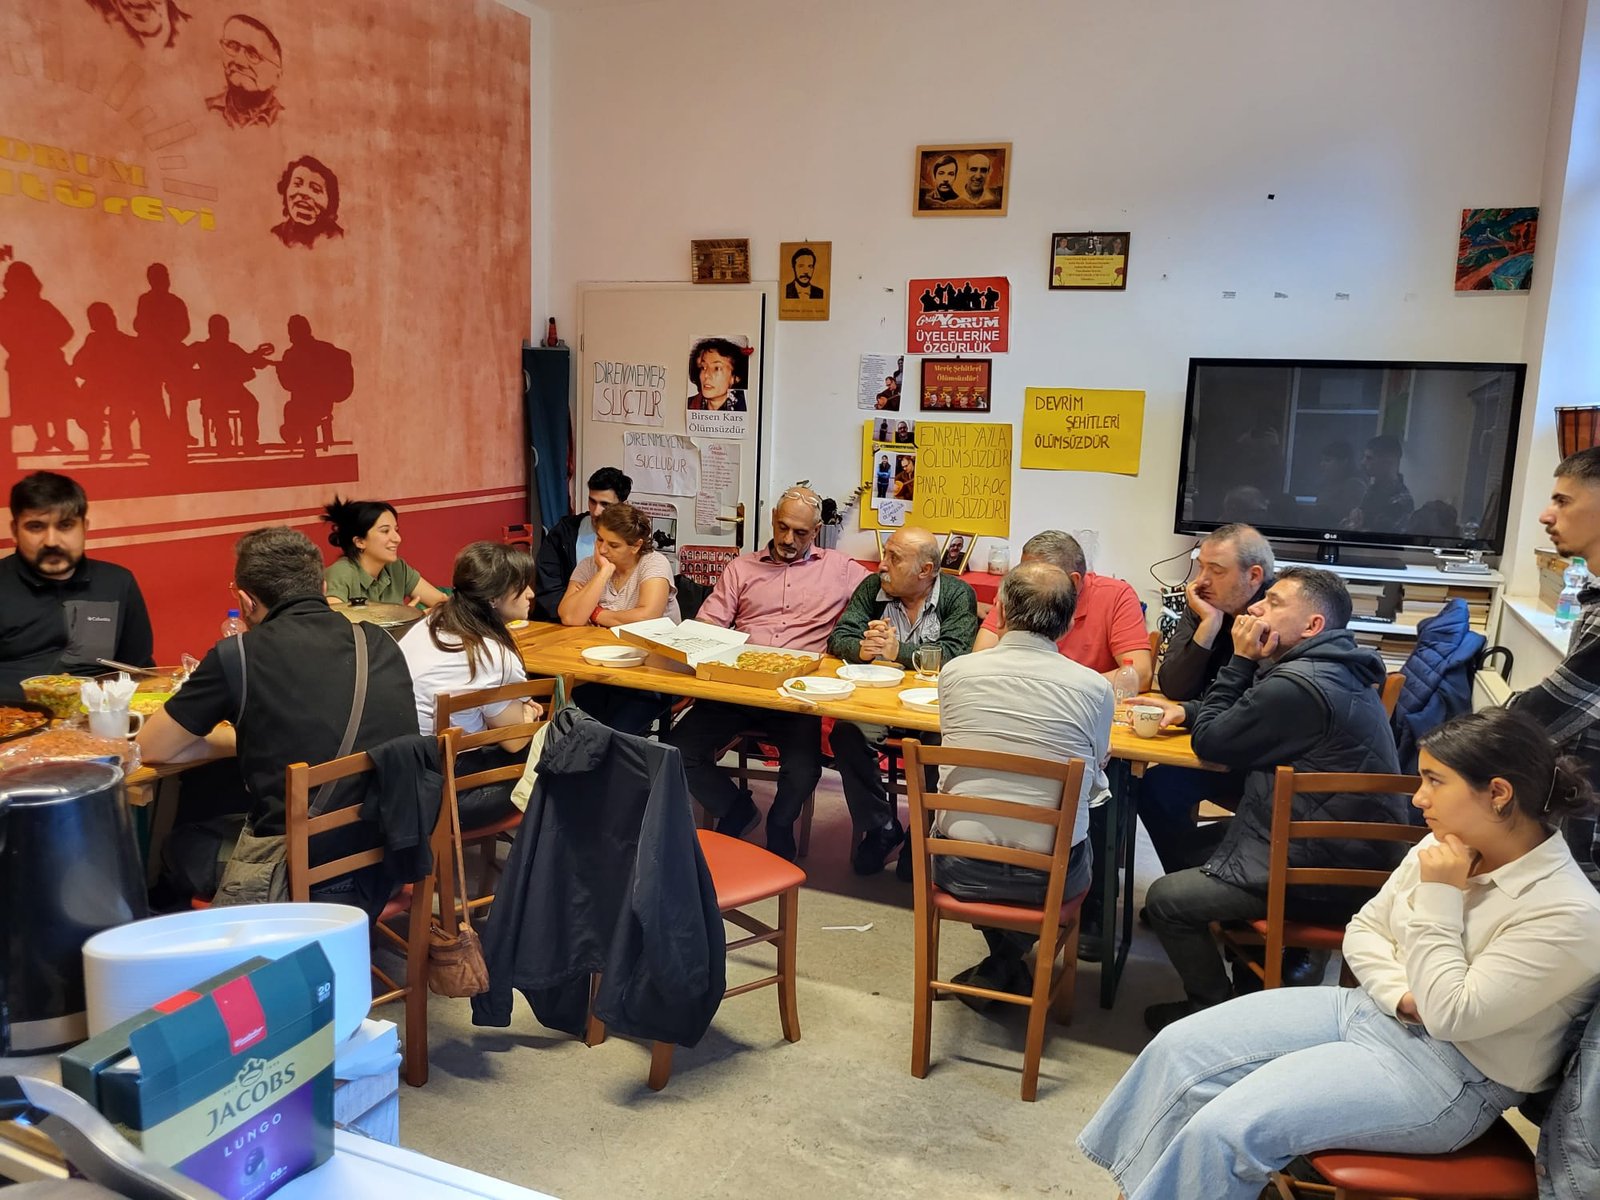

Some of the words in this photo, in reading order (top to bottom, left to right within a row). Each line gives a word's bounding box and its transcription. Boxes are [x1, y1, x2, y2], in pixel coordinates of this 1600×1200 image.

[939, 313, 999, 328] YORUM
[916, 329, 1000, 341] ÜYELELERİNE
[924, 341, 992, 353] ÖZGÜRLÜK
[1035, 394, 1084, 412] DEVRİM
[691, 412, 720, 421] Birsen
[723, 413, 743, 422] Kars
[688, 422, 746, 434] Ölümsüzdür
[920, 425, 967, 447] EMRAH
[974, 426, 1007, 448] YAYLA
[1034, 433, 1110, 450] ÖLÜMSÜZDÜR
[318, 982, 331, 996] 20
[207, 1062, 296, 1137] JACOBS
[223, 1112, 282, 1157] LUNGO
